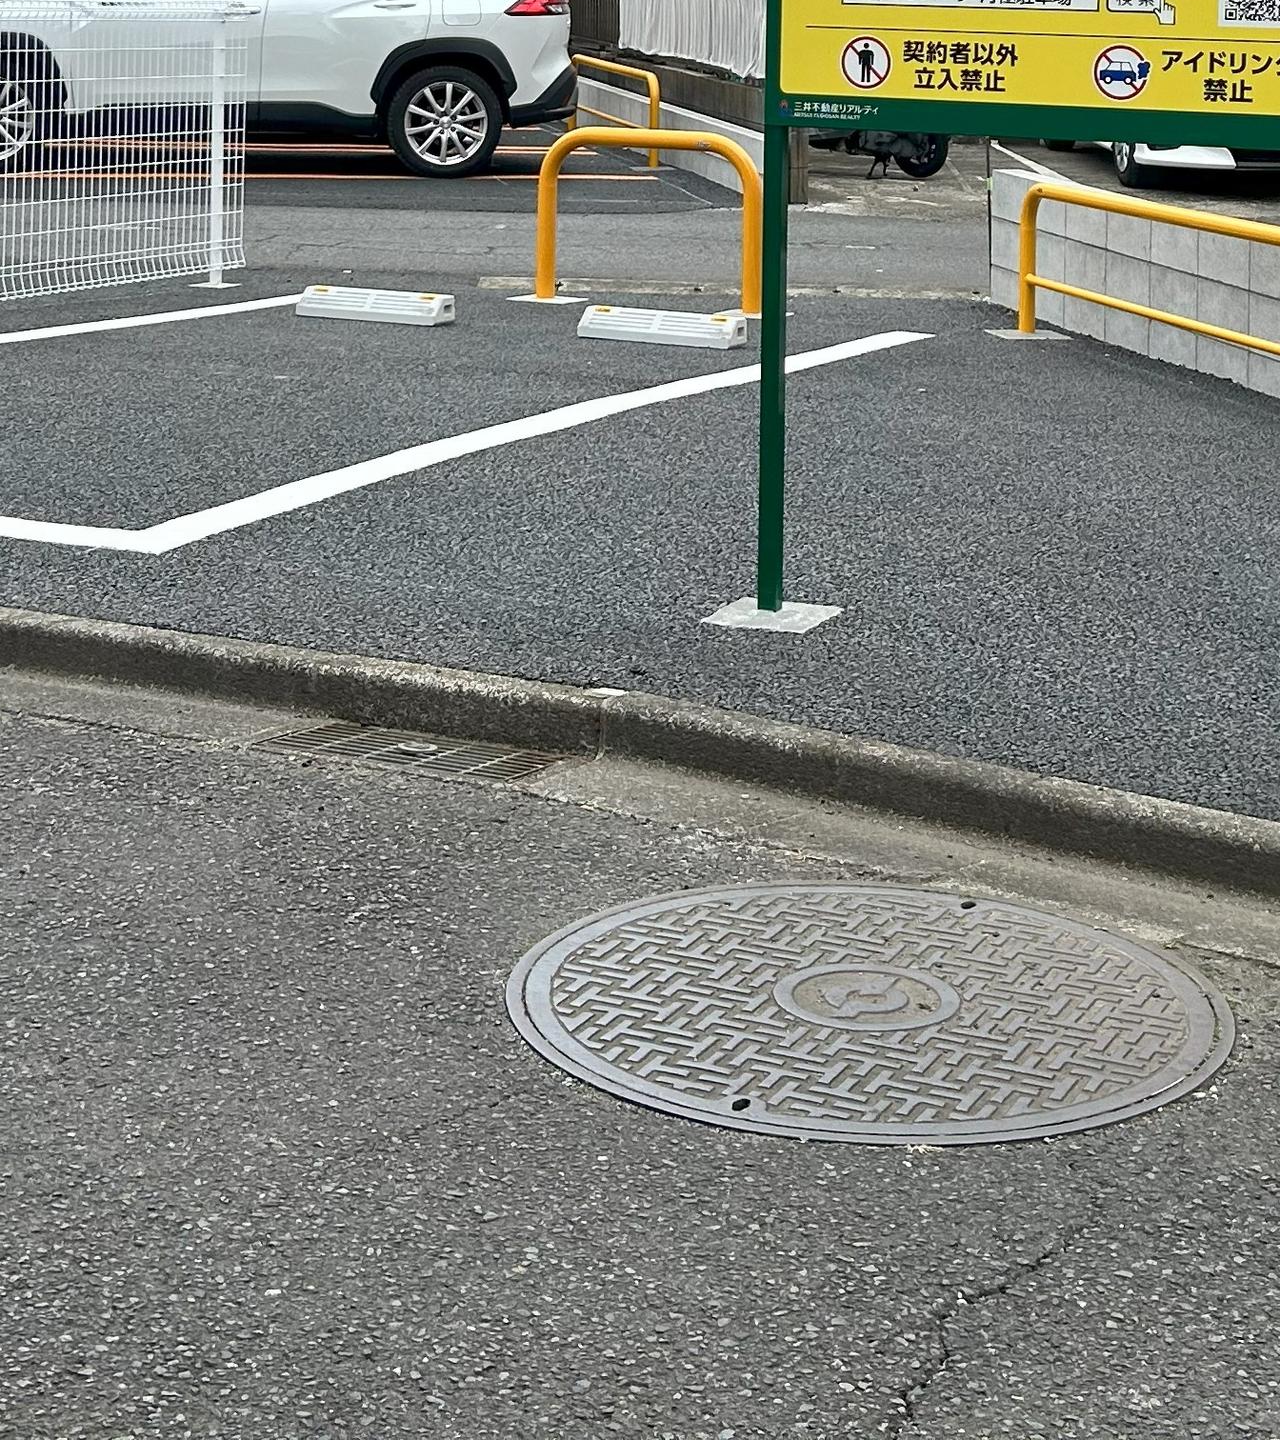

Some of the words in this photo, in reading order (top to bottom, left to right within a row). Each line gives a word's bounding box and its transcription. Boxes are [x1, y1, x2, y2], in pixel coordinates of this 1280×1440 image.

[903, 40, 1019, 67] 契約者以外
[914, 67, 1006, 92] 立入禁止
[1203, 78, 1253, 104] 禁止
